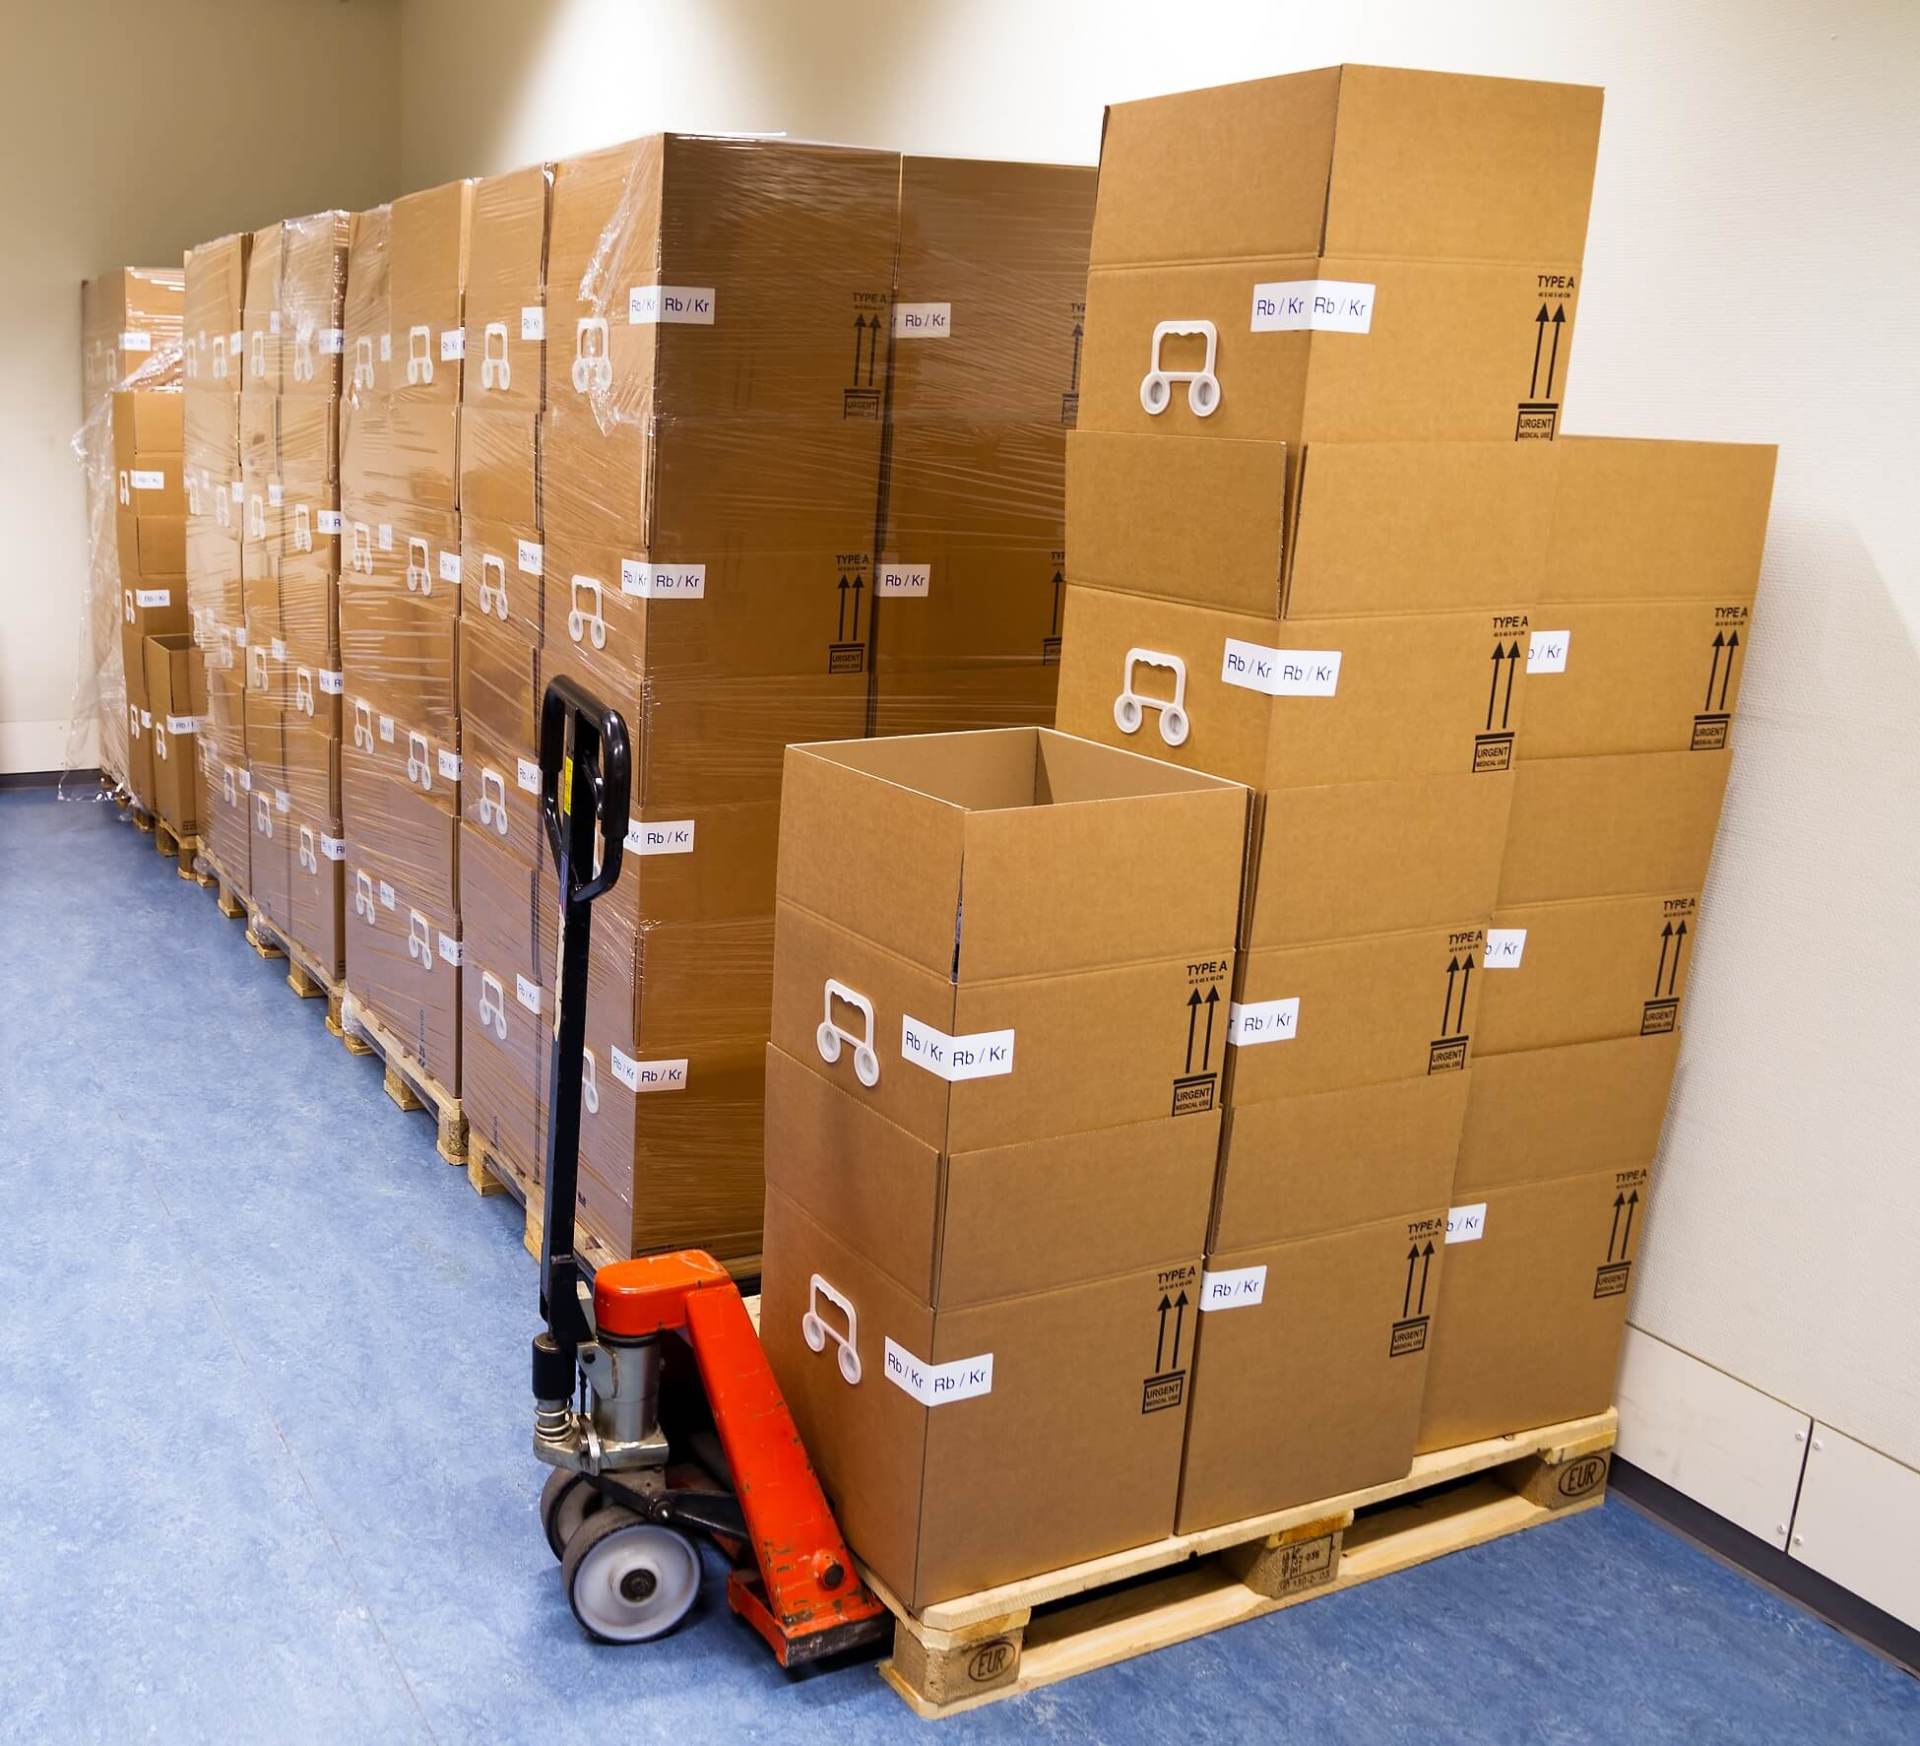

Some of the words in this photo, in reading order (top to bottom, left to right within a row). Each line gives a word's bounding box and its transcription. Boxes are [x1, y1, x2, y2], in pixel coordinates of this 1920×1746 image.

[1537, 275, 1566, 288] TYPE
[1566, 277, 1575, 289] A
[664, 297, 683, 311] Rb
[695, 299, 709, 313] Kr
[1257, 299, 1275, 316] Rb
[1288, 297, 1304, 314] Kr
[1314, 296, 1335, 314] Rb
[1350, 298, 1366, 316] Kr
[905, 314, 922, 327] Rb
[932, 314, 946, 326] Kr
[1520, 418, 1552, 429] URGENT
[836, 554, 861, 565] TYPE
[862, 554, 869, 565] A
[656, 575, 673, 587] Rb
[685, 576, 699, 587] Kr
[886, 574, 902, 587] Rb
[912, 574, 925, 587] Kr
[1715, 607, 1740, 618] TYPE
[1740, 607, 1748, 618] A
[1493, 616, 1520, 628] TYPE
[1520, 615, 1528, 627] A
[1228, 653, 1245, 672] Rb
[1257, 661, 1272, 679] Kr
[1284, 665, 1303, 681] Rb
[1316, 665, 1332, 681] Kr
[1477, 746, 1508, 758] URGENT
[647, 833, 664, 845] Rb
[674, 831, 689, 842] Kr
[1664, 898, 1689, 911] TYPE
[1688, 897, 1696, 908] A
[1449, 931, 1475, 945] TYPE
[1475, 930, 1483, 940] A
[1187, 961, 1217, 976] TYPE
[1218, 960, 1228, 972] A
[1244, 1016, 1263, 1031] Rb
[1276, 1012, 1292, 1027] Kr
[906, 1030, 920, 1051] Rb
[931, 1043, 943, 1062] Kr
[953, 1050, 974, 1067] Rb
[990, 1046, 1007, 1061] Kr
[641, 1070, 658, 1082] Rb
[669, 1069, 682, 1080] Kr
[1176, 1088, 1210, 1102] URGENT
[1615, 1169, 1640, 1183] TYPE
[1640, 1168, 1647, 1178] A
[1408, 1219, 1434, 1234] TYPE
[1434, 1218, 1442, 1229] A
[1465, 1215, 1479, 1229] Kr
[1157, 1267, 1186, 1284] TYPE
[1187, 1265, 1196, 1277] A
[1213, 1283, 1231, 1298] Rb
[1243, 1278, 1259, 1293] Kr
[1394, 1329, 1424, 1344] URGENT
[888, 1352, 902, 1374] Rb
[911, 1369, 924, 1388] Kr
[934, 1376, 954, 1393] Rb
[969, 1369, 986, 1385] Kr
[1146, 1383, 1180, 1399] URGENT
[1568, 1461, 1597, 1491] EUR
[977, 1646, 1007, 1677] EUR
